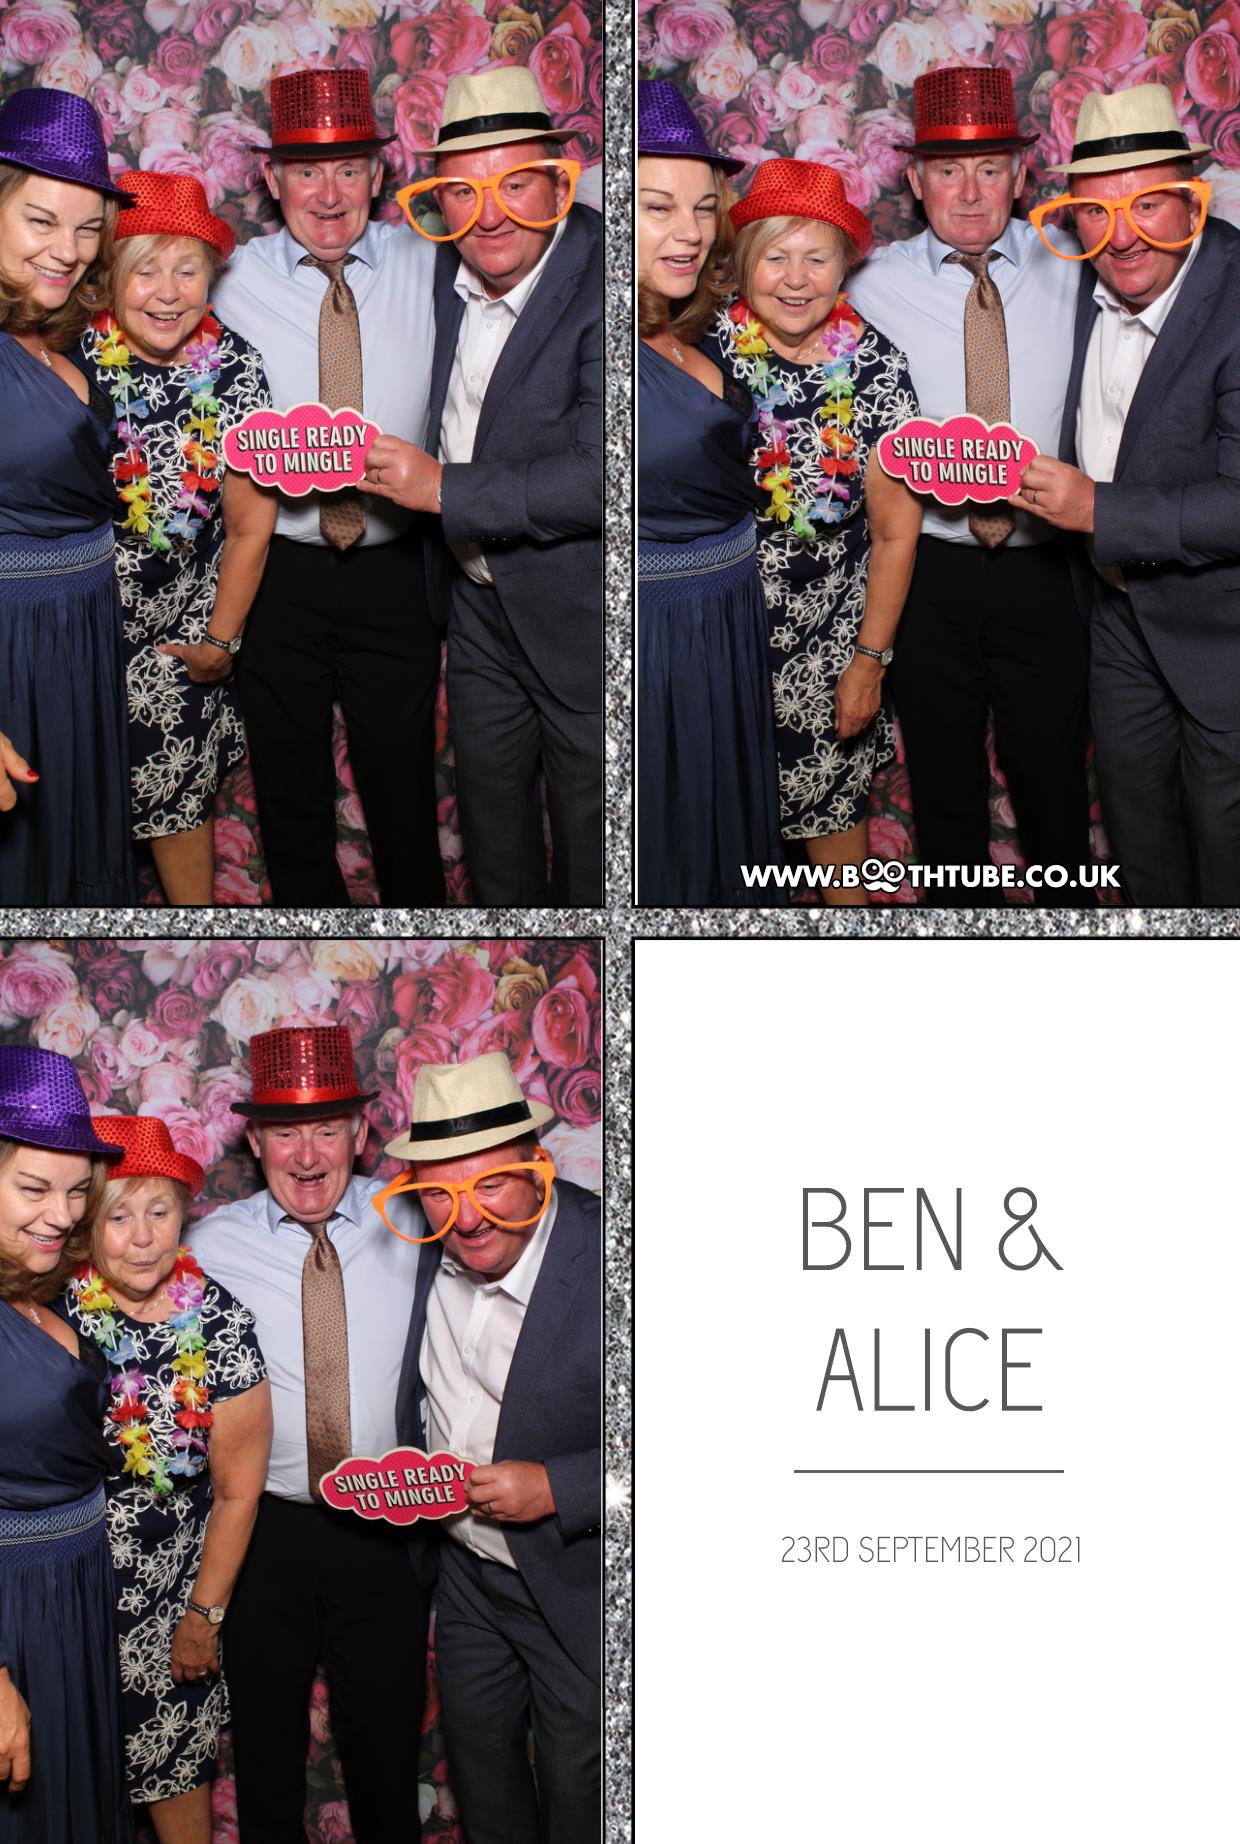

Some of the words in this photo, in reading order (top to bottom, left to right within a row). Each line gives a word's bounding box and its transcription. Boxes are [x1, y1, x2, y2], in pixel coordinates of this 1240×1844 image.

[236, 427, 300, 451] SINGLE
[306, 424, 367, 448] READY
[893, 437, 955, 459] SINGLE
[962, 439, 1024, 462] READY
[254, 453, 277, 474] TO
[284, 450, 353, 474] MINGLE
[909, 461, 932, 482] TO
[939, 462, 1008, 485] MINGLE
[334, 1470, 400, 1494] SINGLE
[404, 1463, 465, 1486] READY
[355, 1492, 380, 1511] TO
[385, 1485, 455, 1508] MINGLE
